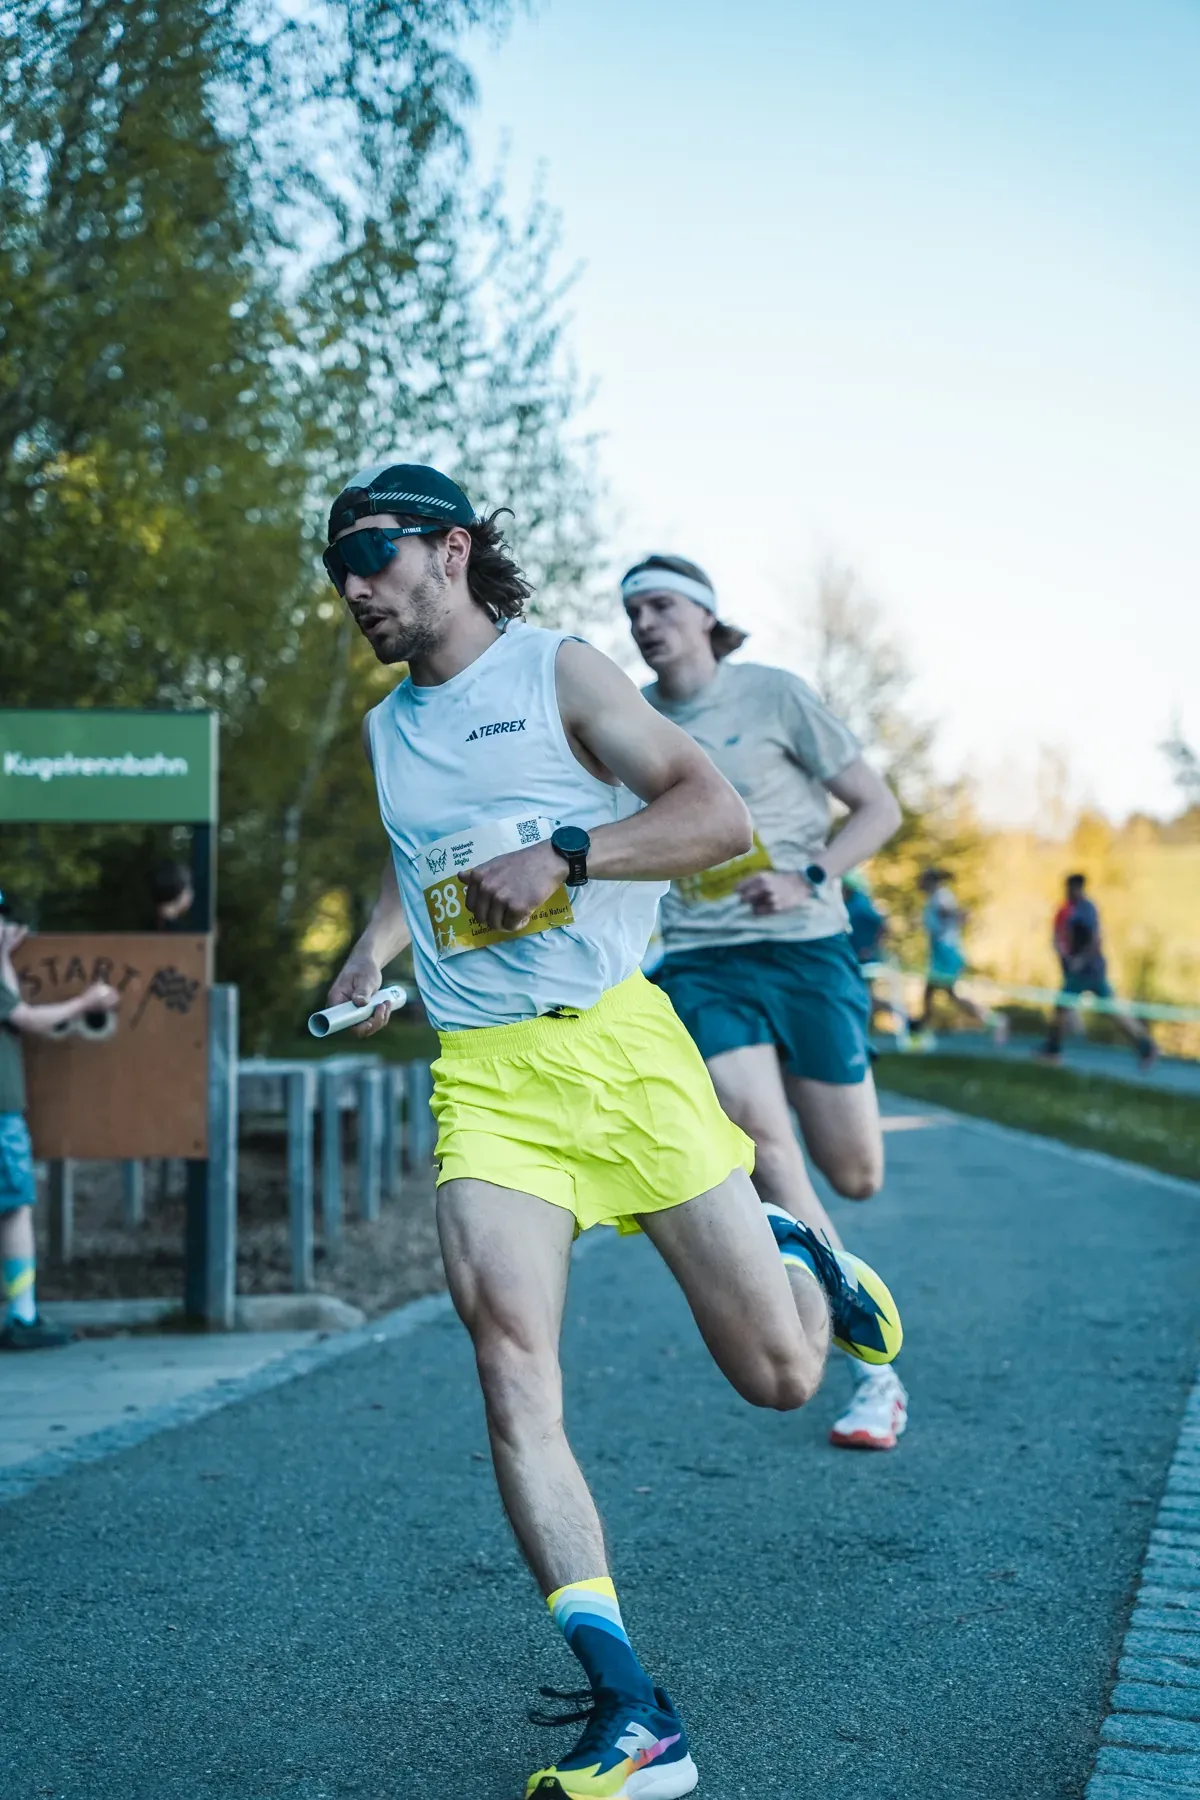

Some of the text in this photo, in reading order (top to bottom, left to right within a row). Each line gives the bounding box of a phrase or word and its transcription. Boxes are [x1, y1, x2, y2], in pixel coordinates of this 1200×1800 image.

[479, 718, 527, 738] TERREX
[3, 751, 188, 782] Kugelrennbahn
[452, 848, 473, 860] Skywalk
[454, 857, 470, 867] Allgäu
[430, 884, 461, 923] 38
[539, 910, 549, 919] die
[549, 905, 569, 916] Natur!
[18, 955, 141, 1000] START
